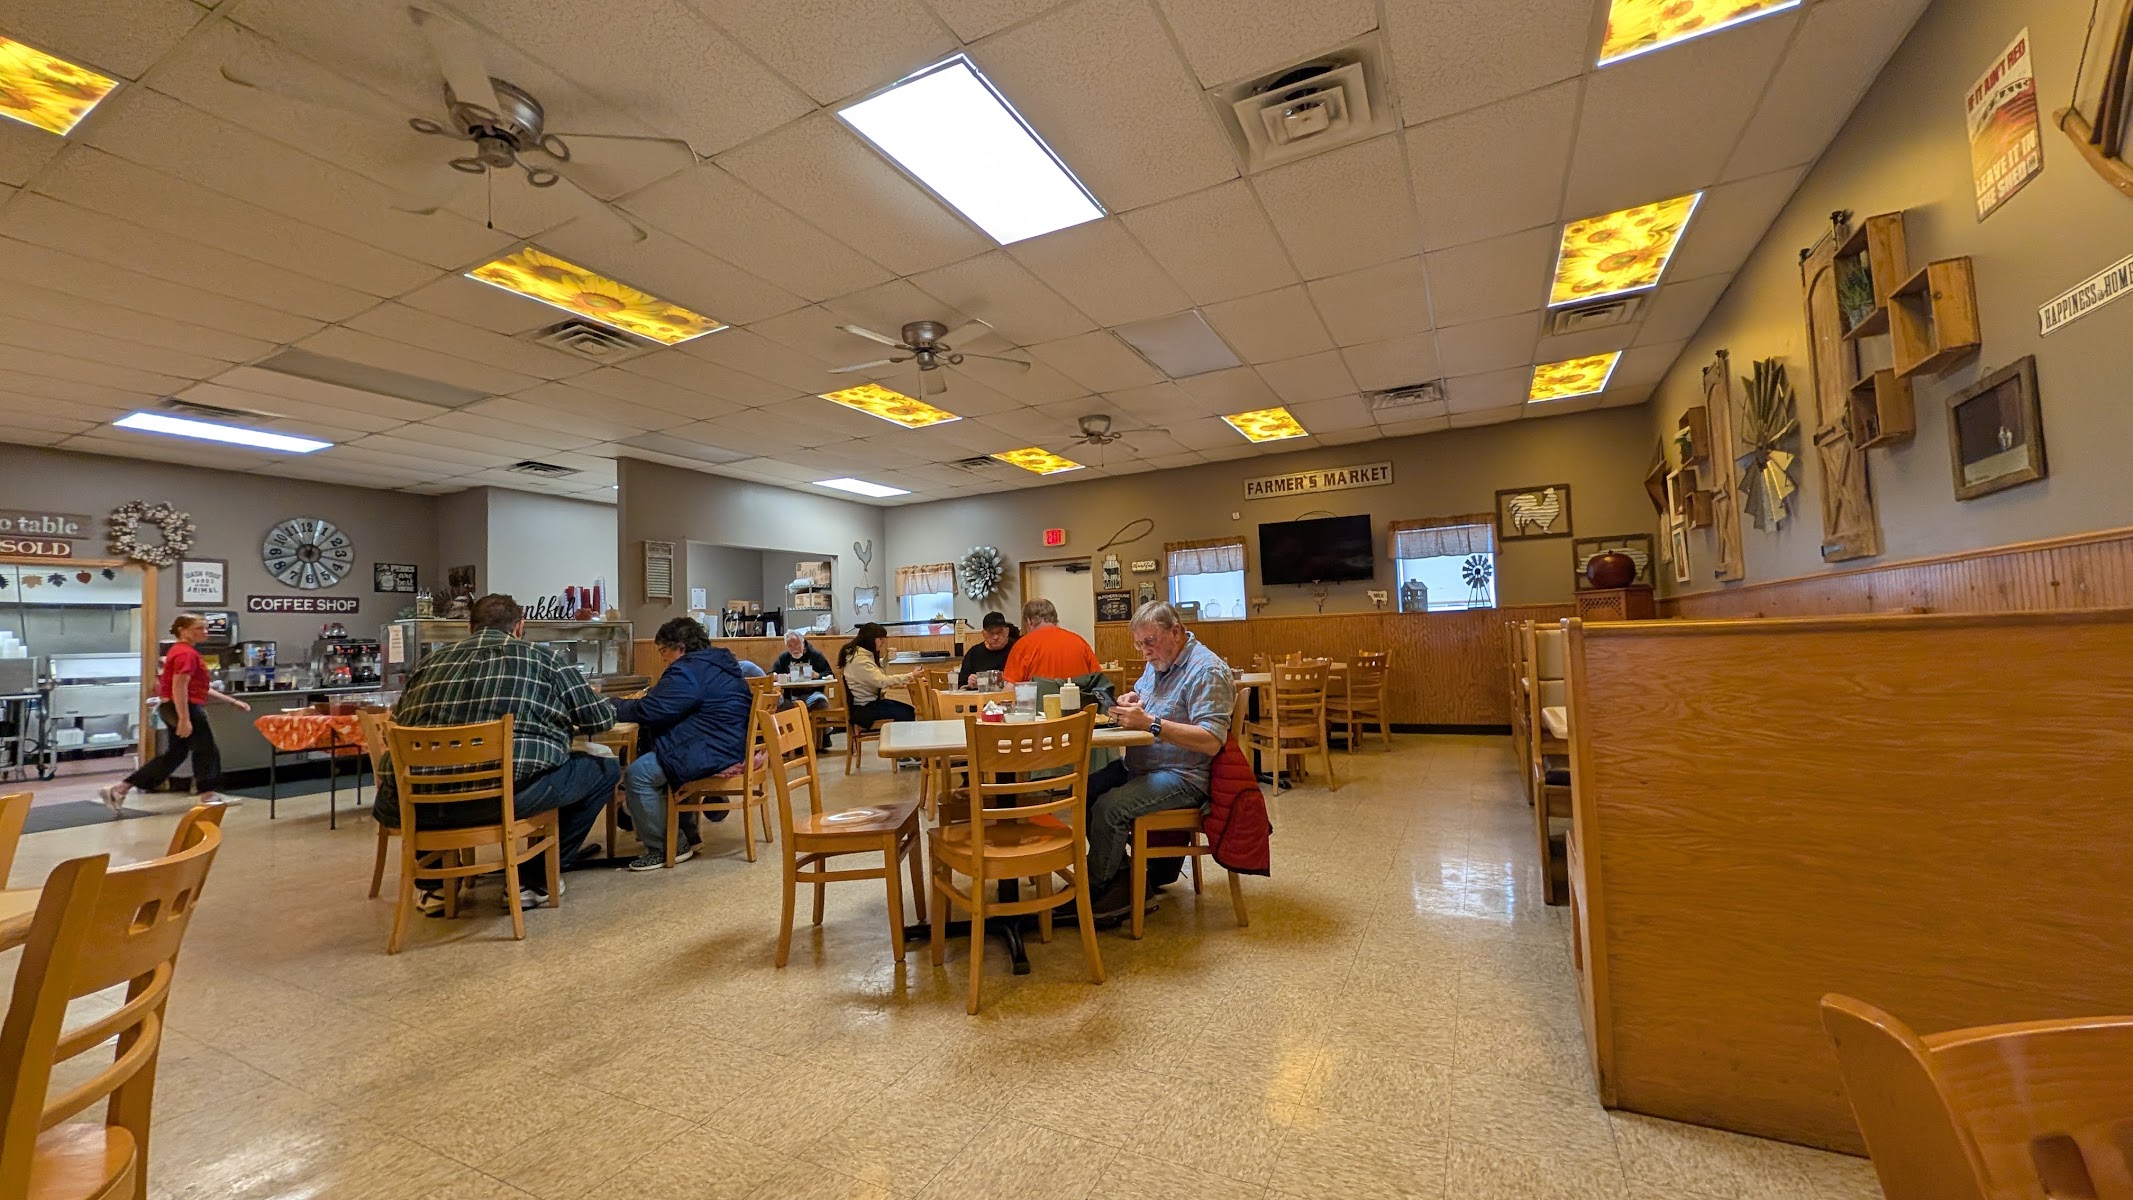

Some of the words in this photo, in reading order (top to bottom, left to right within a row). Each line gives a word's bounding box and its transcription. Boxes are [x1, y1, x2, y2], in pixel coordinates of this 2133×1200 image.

[1967, 94, 1975, 113] IF
[1975, 84, 1983, 105] IT
[1984, 58, 2006, 96] AIN'T
[2007, 37, 2026, 70] RED
[1975, 155, 2008, 198] LEAVE
[2007, 143, 2020, 169] IT
[2021, 129, 2036, 156] IN
[1977, 187, 1998, 215] THE
[1997, 160, 2028, 199] SHED
[2044, 282, 2097, 329] HAPPINESS
[1247, 474, 1318, 495] FARMER'S
[1323, 466, 1388, 487] MARKET
[17, 516, 79, 535] table
[285, 525, 299, 537] 11
[301, 522, 313, 532] 12
[321, 527, 329, 536] 1
[273, 533, 288, 546] 10
[330, 537, 342, 547] 2
[1046, 530, 1062, 545] EXIT
[0, 540, 71, 556] SOLD
[269, 548, 282, 556] 9
[335, 550, 347, 558] 3
[273, 560, 287, 570] 8
[332, 563, 344, 571] 4
[290, 570, 299, 580] 7
[305, 574, 314, 584] 6
[320, 570, 331, 581] 5
[250, 597, 314, 611] COFFEE
[316, 598, 357, 611] SHOP
[520, 595, 576, 619] nkful
